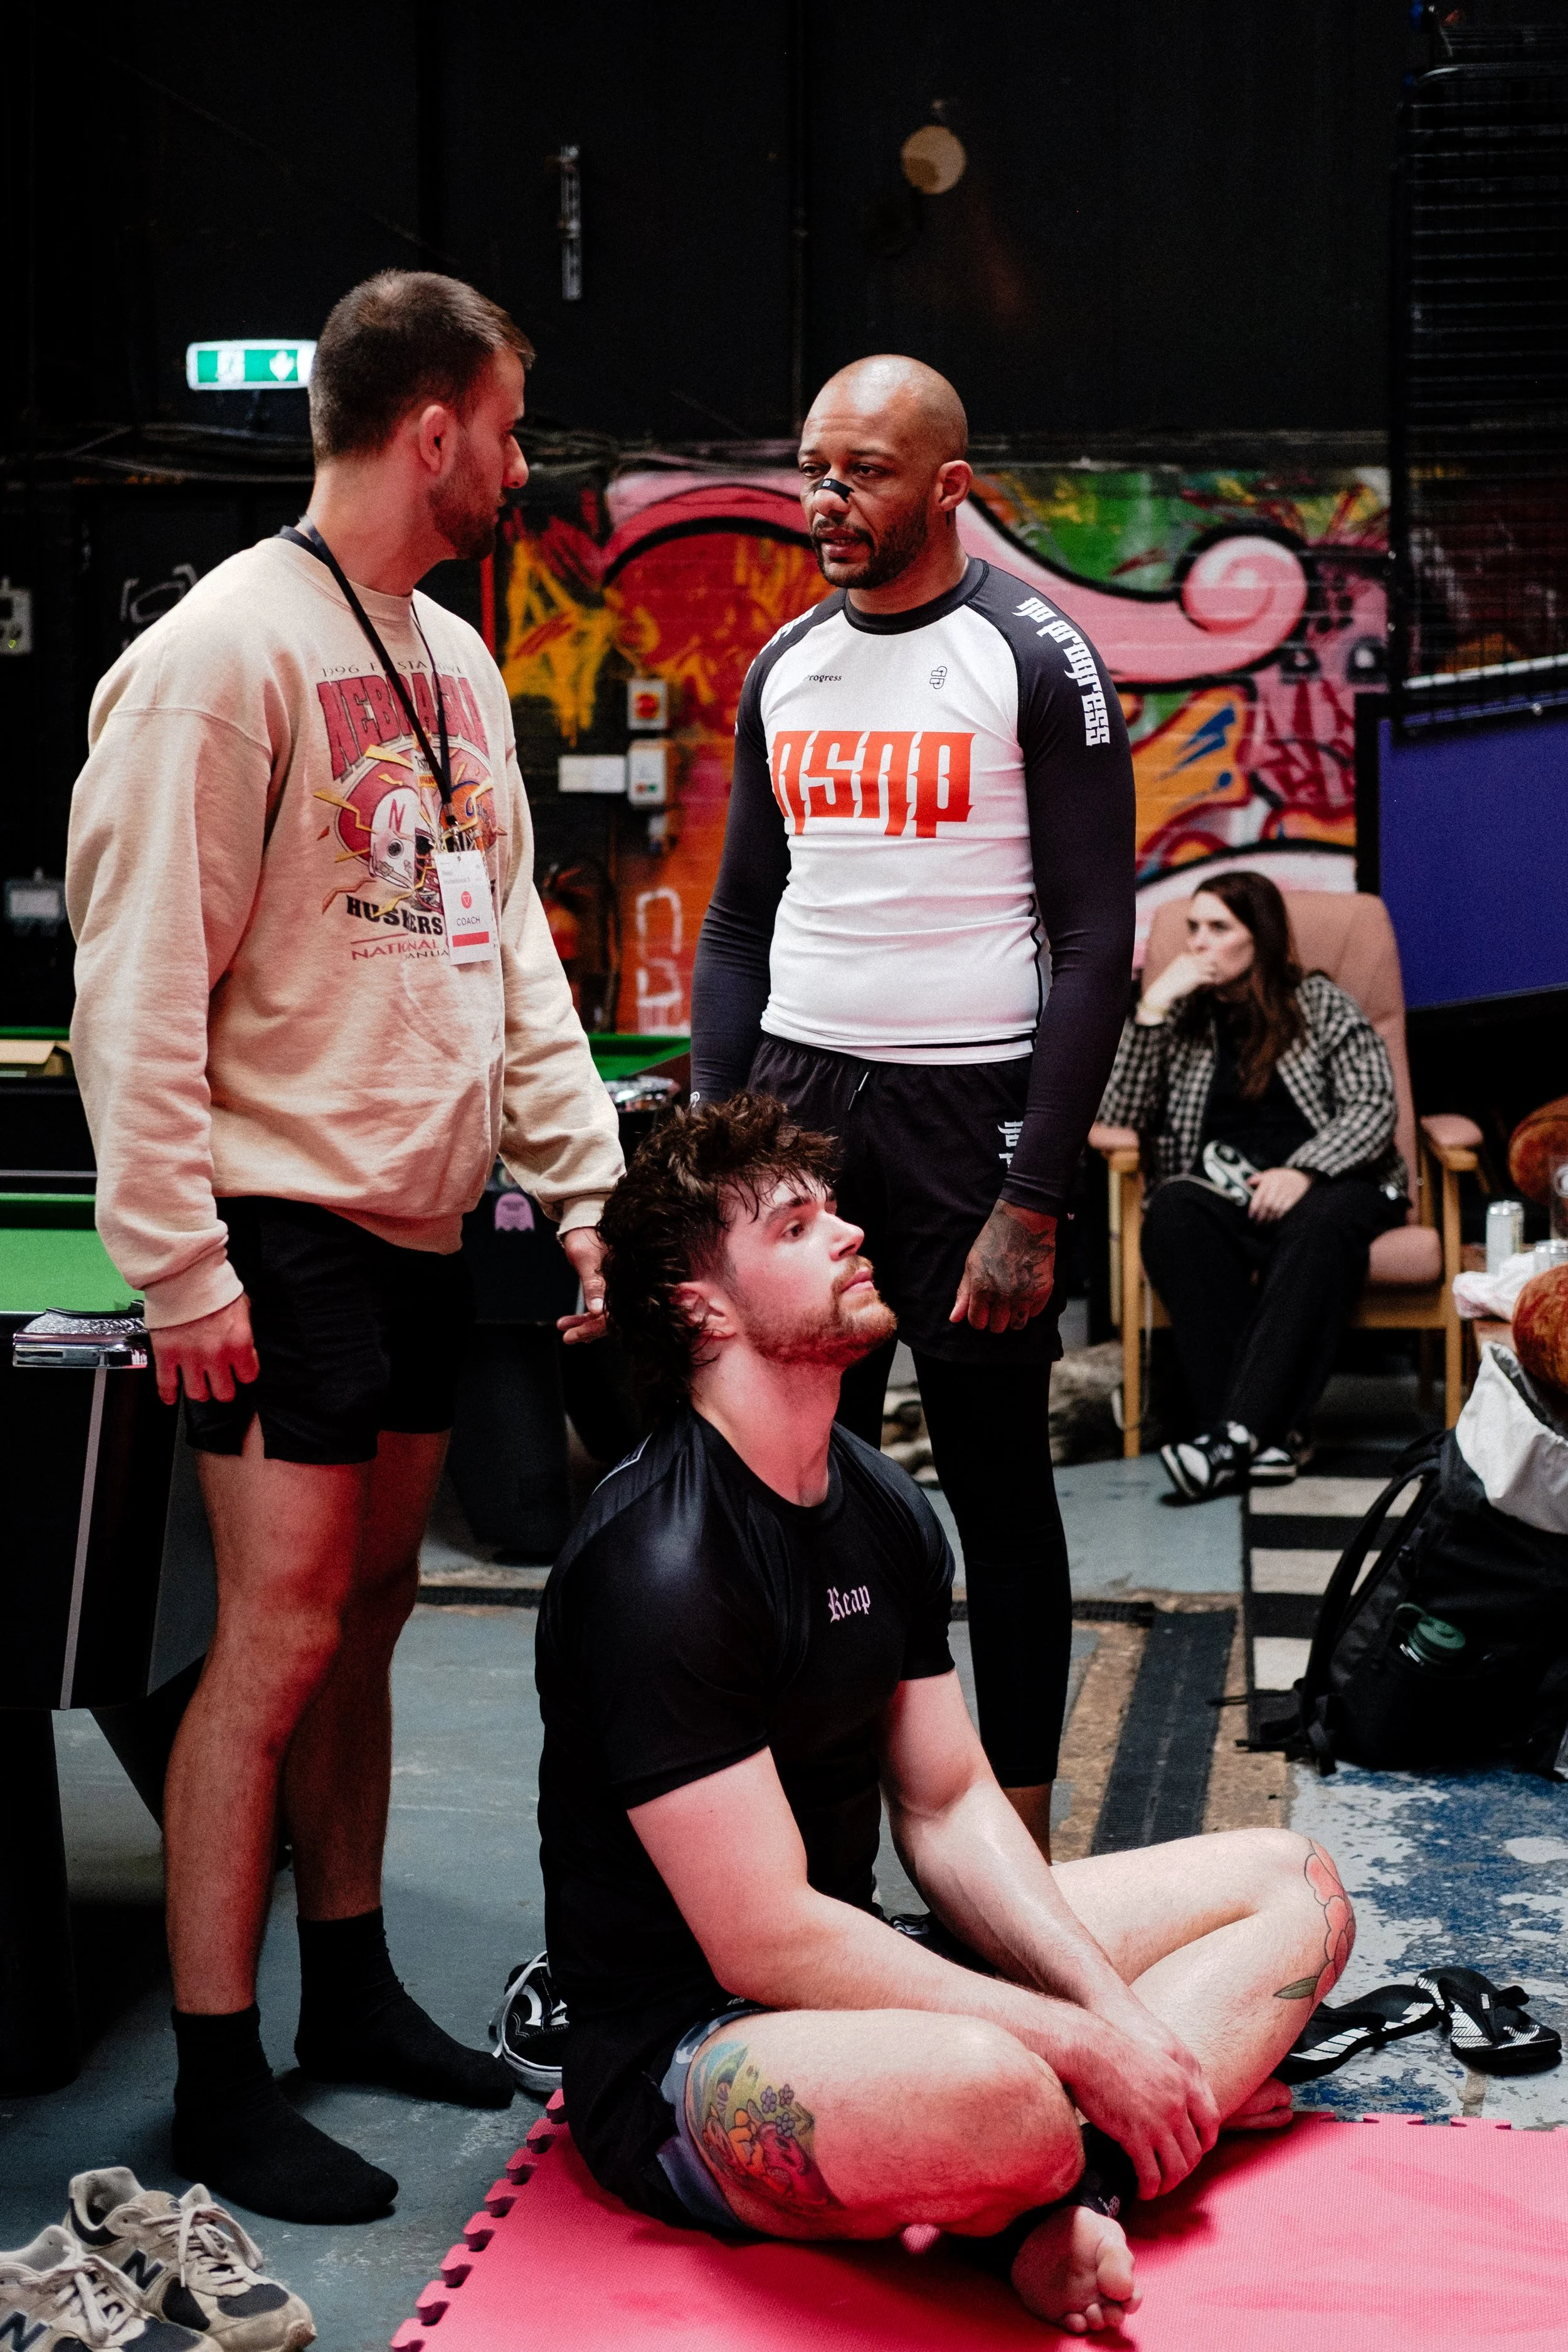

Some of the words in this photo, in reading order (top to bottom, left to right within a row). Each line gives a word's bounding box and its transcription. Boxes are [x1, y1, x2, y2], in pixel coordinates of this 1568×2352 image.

[322, 665, 359, 677] 1996
[370, 660, 427, 671] FSTA
[437, 662, 462, 674] OWL
[457, 916, 481, 926] COACH
[352, 939, 439, 960] NATIONAL
[827, 1586, 871, 1623] Reap
